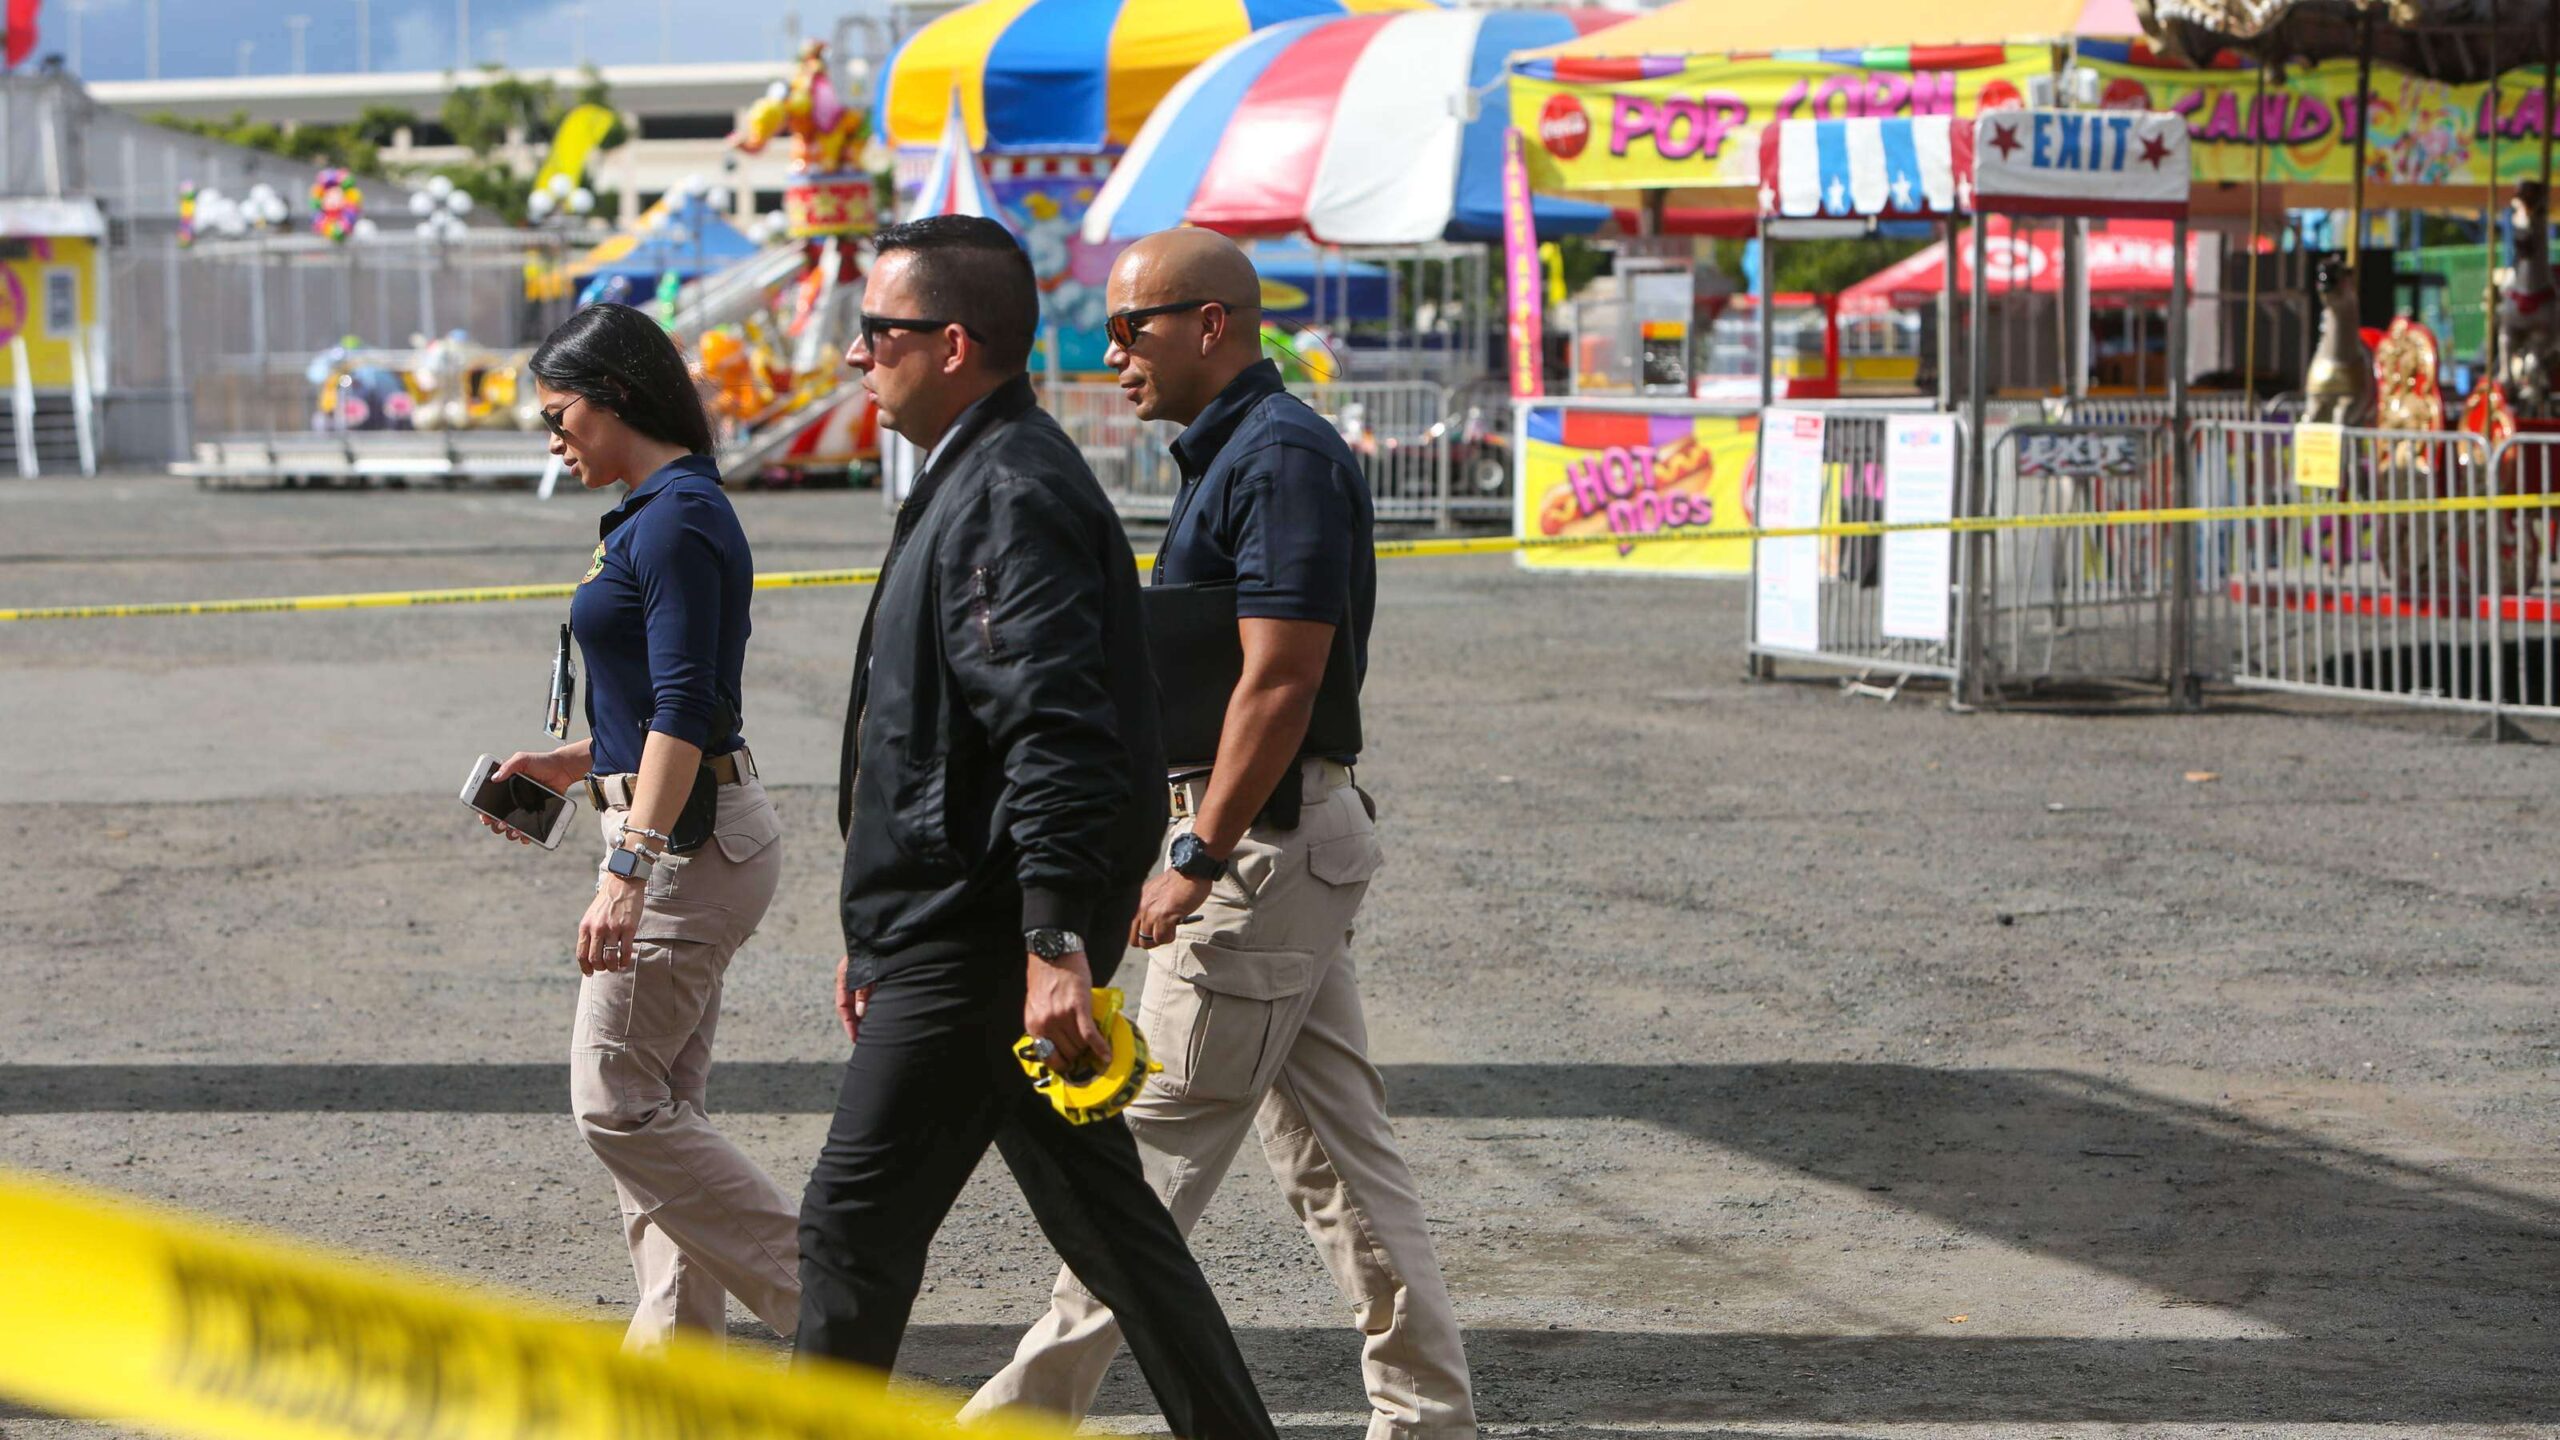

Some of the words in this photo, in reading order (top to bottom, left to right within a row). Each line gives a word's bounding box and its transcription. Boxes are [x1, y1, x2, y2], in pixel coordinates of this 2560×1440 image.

[1610, 90, 1749, 160] POP
[2032, 113, 2132, 172] EXIT
[1566, 444, 1658, 518] HOT
[2027, 433, 2128, 464] EXIT
[1607, 489, 1712, 557] DOGS
